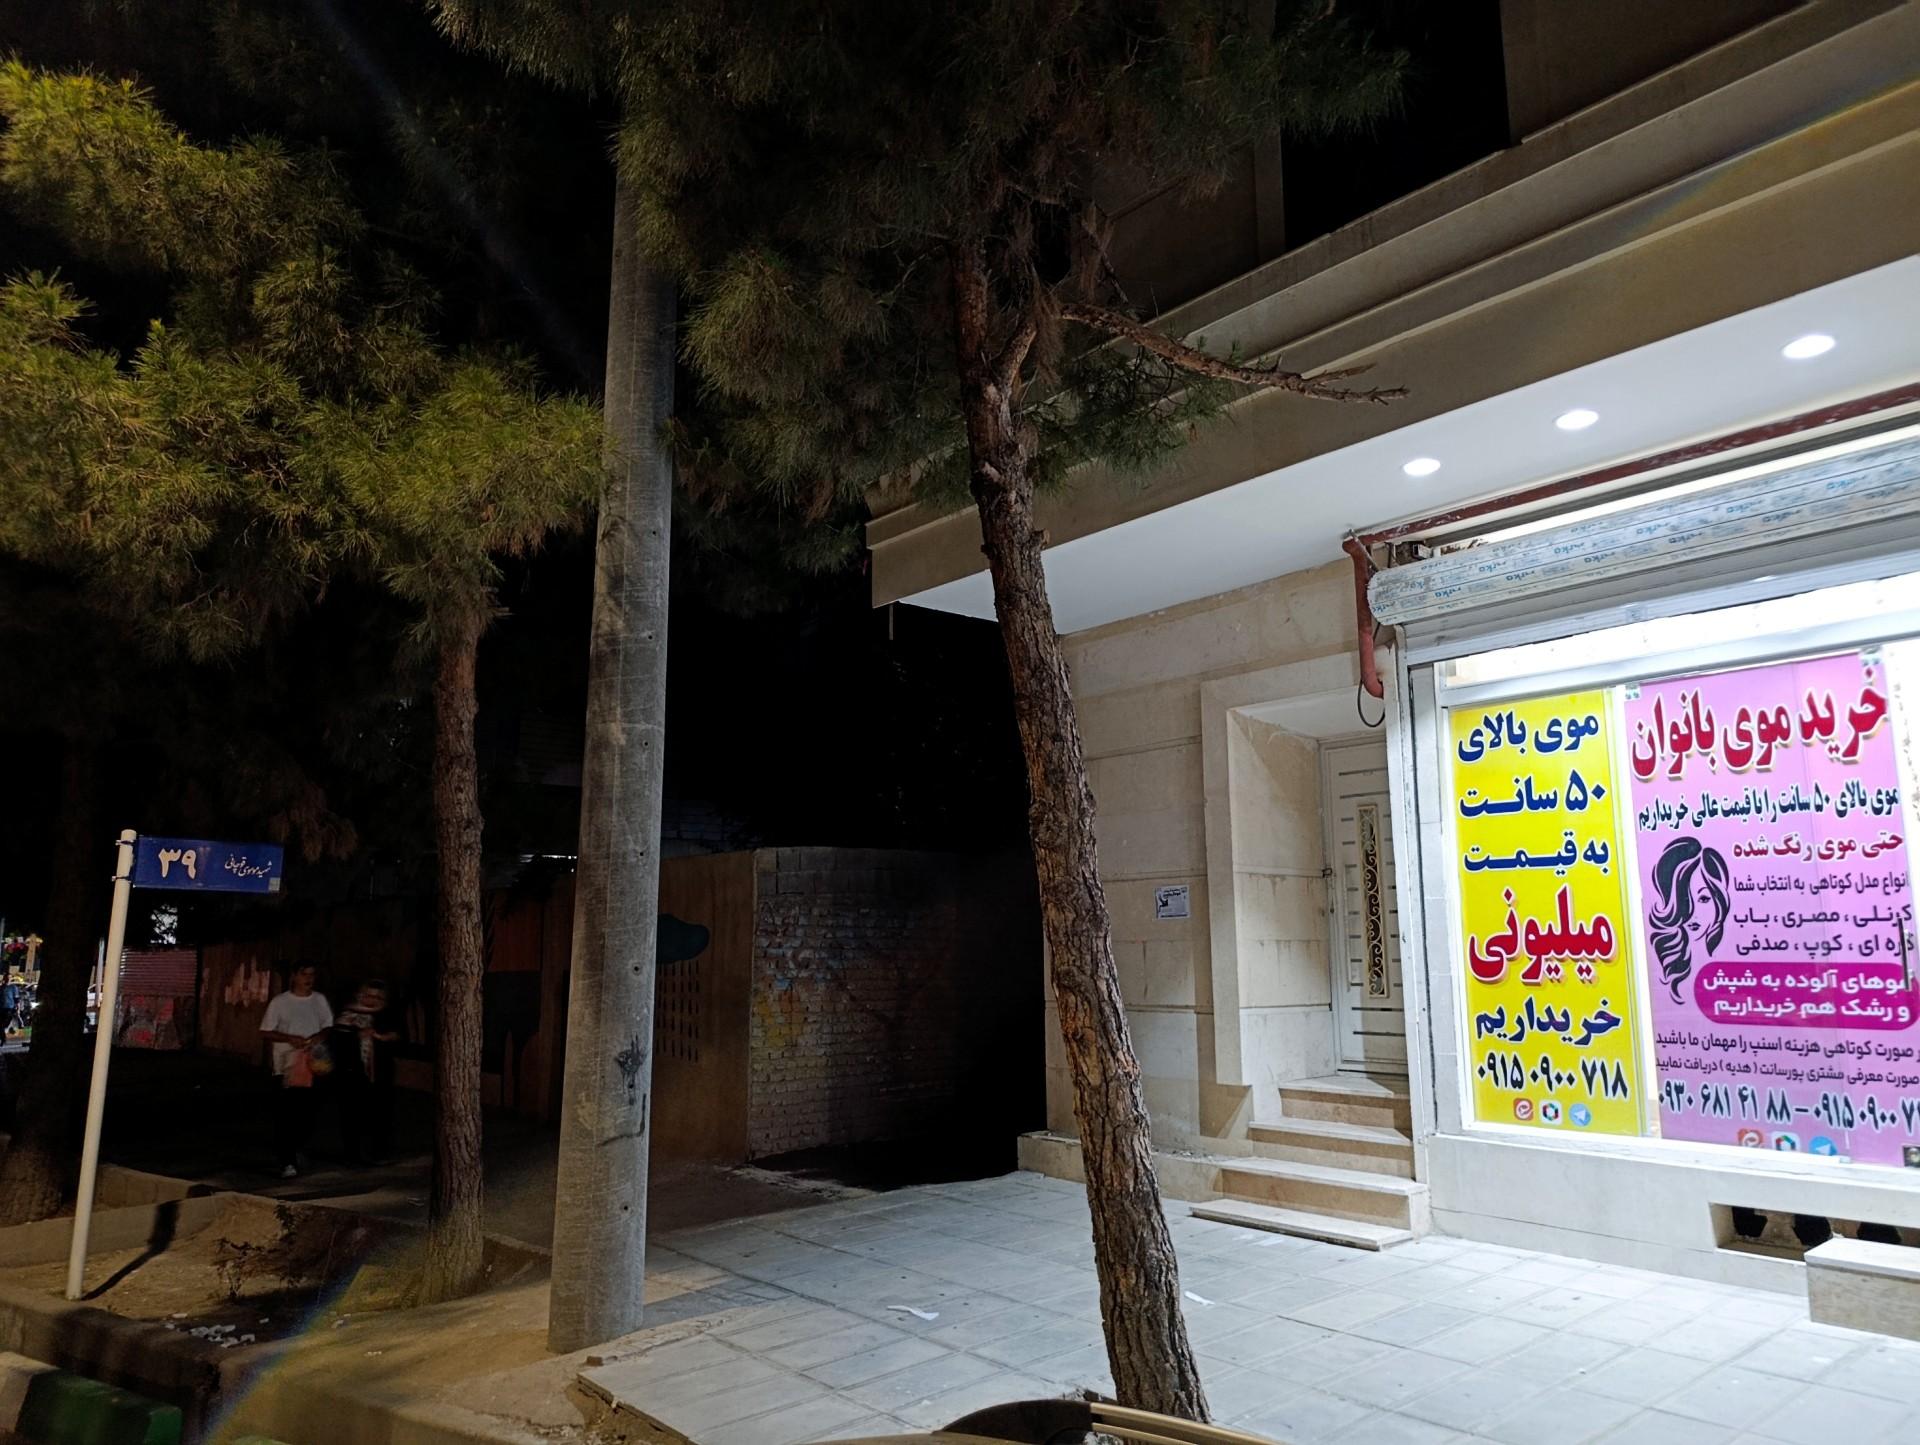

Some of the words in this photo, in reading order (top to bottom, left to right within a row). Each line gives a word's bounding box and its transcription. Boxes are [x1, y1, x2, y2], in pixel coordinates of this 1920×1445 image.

[1800, 668, 1888, 758] خرید
[1458, 711, 1526, 761] بالای
[1534, 715, 1599, 753] موی
[1632, 690, 1715, 776] بانوان
[1723, 706, 1791, 768] موی
[1460, 776, 1558, 817] سانت
[1565, 769, 1606, 811] ۵۰
[1779, 785, 1811, 813] سانت
[1814, 782, 1830, 812] ۵۰
[1835, 780, 1867, 818] بالای
[1871, 788, 1899, 815] موی
[1639, 794, 1689, 831] خریداریم
[1692, 793, 1719, 827] عالی
[1721, 787, 1751, 822] قیمت
[1753, 789, 1763, 822] با
[1764, 788, 1777, 822] را
[1464, 831, 1577, 875] قیمت
[1733, 836, 1769, 857] شده
[1773, 833, 1812, 861] رنگ
[1817, 839, 1857, 860] موی
[1862, 832, 1903, 858] حتی
[158, 848, 197, 879] ۳۹
[1583, 840, 1609, 874] به
[1734, 874, 1755, 891] شما
[1757, 874, 1792, 896] انتخاب
[1794, 877, 1805, 895] به
[1809, 872, 1852, 895] کوتاهی
[1855, 872, 1879, 894] مدل
[1733, 908, 1770, 928] باب
[1469, 885, 1614, 980] میلیونی
[1736, 934, 1789, 955] صدفی
[1703, 969, 1757, 993] شپش
[1761, 973, 1781, 992] به
[1785, 969, 1838, 992] آلوده
[1714, 997, 1796, 1017] خریداریم
[1801, 1001, 1837, 1017] هم
[1841, 998, 1892, 1021] رشک
[1476, 996, 1621, 1045] خریداریم
[1656, 1030, 1686, 1049] باشید
[1688, 1032, 1699, 1046] ما
[1701, 1033, 1737, 1052] مهمان
[1739, 1034, 1747, 1053] را
[1749, 1036, 1782, 1057] اسنپ
[1785, 1039, 1820, 1057] هزینه
[1823, 1040, 1872, 1060] کوتاهی
[1656, 1056, 1682, 1072] نمایید
[1875, 1043, 1914, 1062] صورت
[1684, 1057, 1718, 1075] دریافت
[1807, 1065, 1845, 1082] مشتری
[1847, 1067, 1884, 1085] معرفی
[1886, 1071, 1920, 1088] صورت
